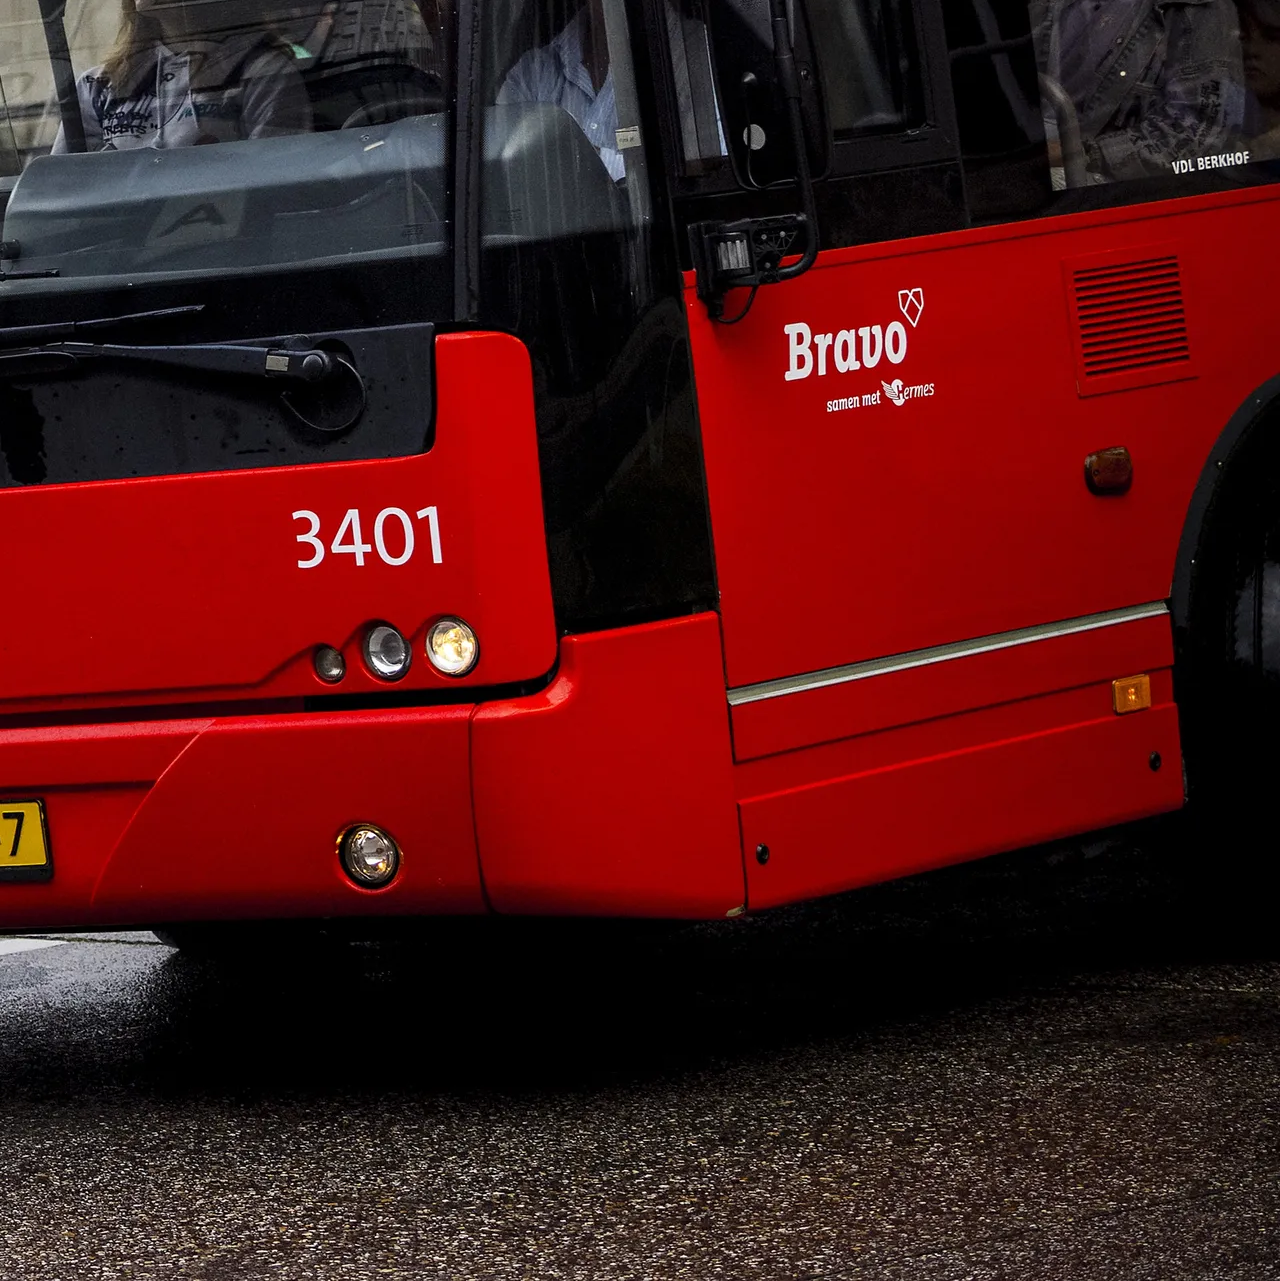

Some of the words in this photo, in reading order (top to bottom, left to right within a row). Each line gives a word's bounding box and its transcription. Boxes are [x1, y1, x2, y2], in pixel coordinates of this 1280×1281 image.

[1171, 158, 1195, 175] VDL
[1196, 150, 1250, 173] BERKHOF
[783, 320, 908, 382] Bravo
[827, 396, 860, 412] samen
[862, 390, 881, 407] met
[291, 505, 443, 569] 3401
